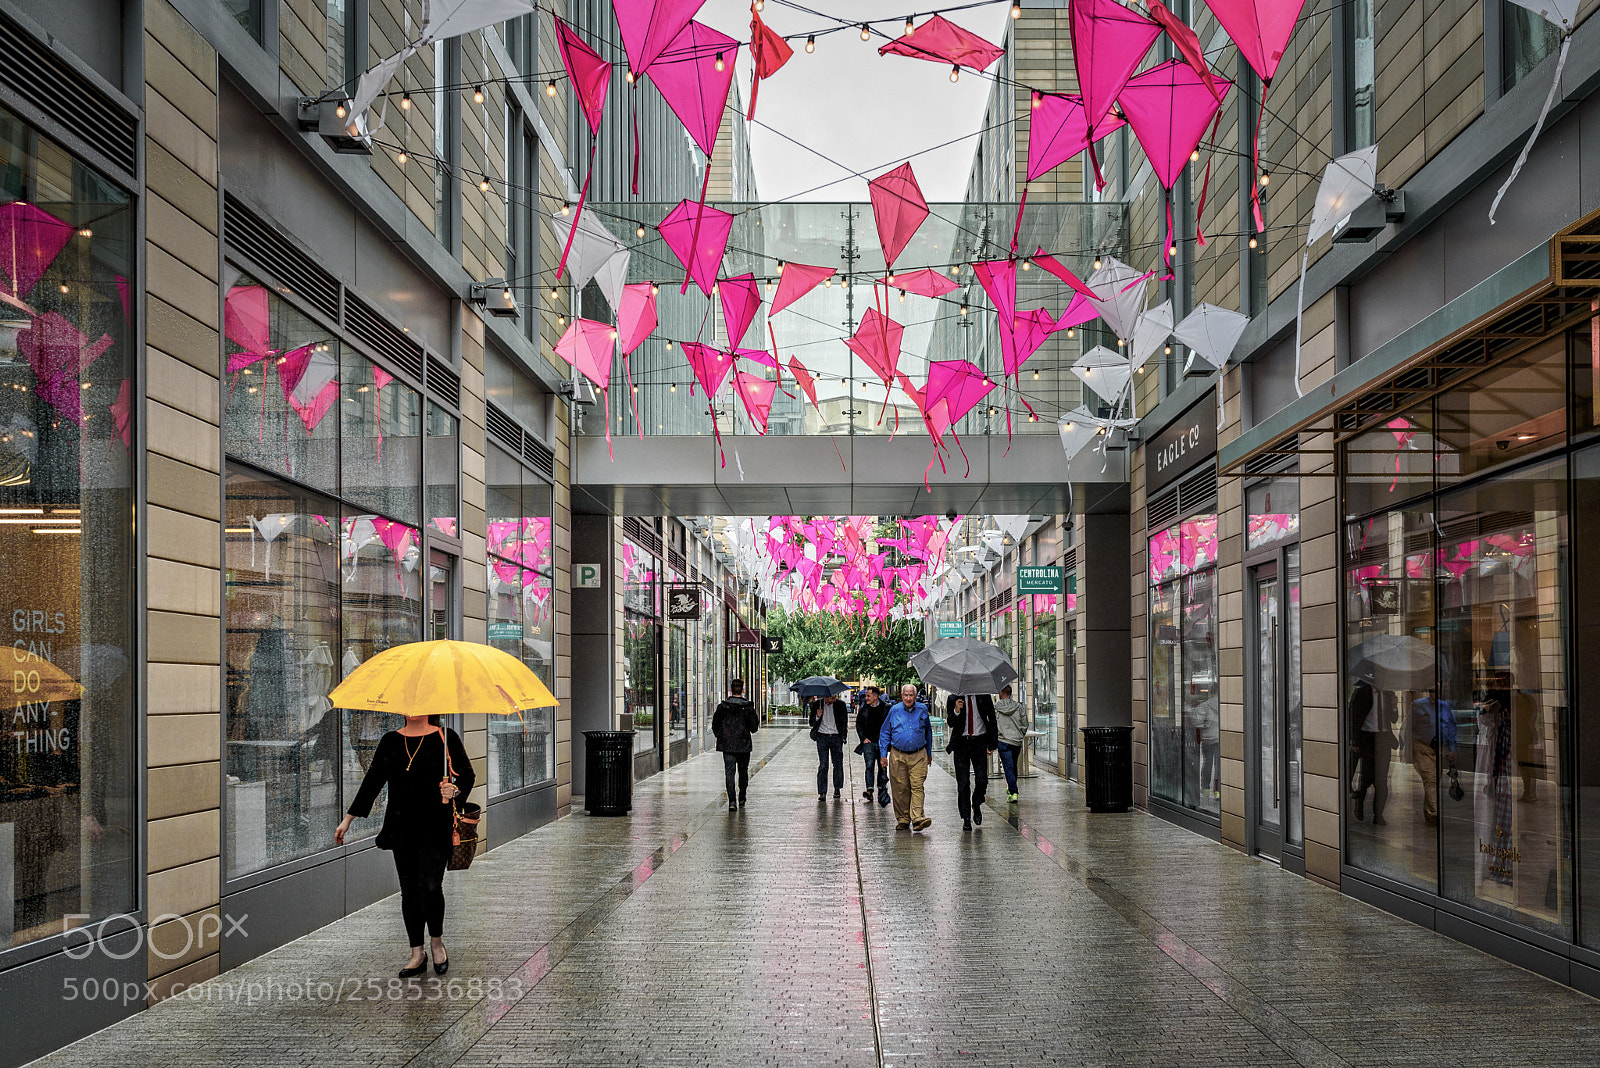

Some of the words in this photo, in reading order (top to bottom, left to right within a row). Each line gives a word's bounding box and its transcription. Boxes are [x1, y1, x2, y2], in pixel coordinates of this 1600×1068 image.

[1157, 434, 1186, 472] EAGLE
[581, 566, 596, 585] P
[1019, 568, 1060, 578] CENTROLINA
[12, 608, 66, 635] GIRLS
[13, 639, 52, 663] CAN
[14, 669, 41, 694] DO
[12, 699, 58, 724] ANY-
[13, 727, 71, 755] THING
